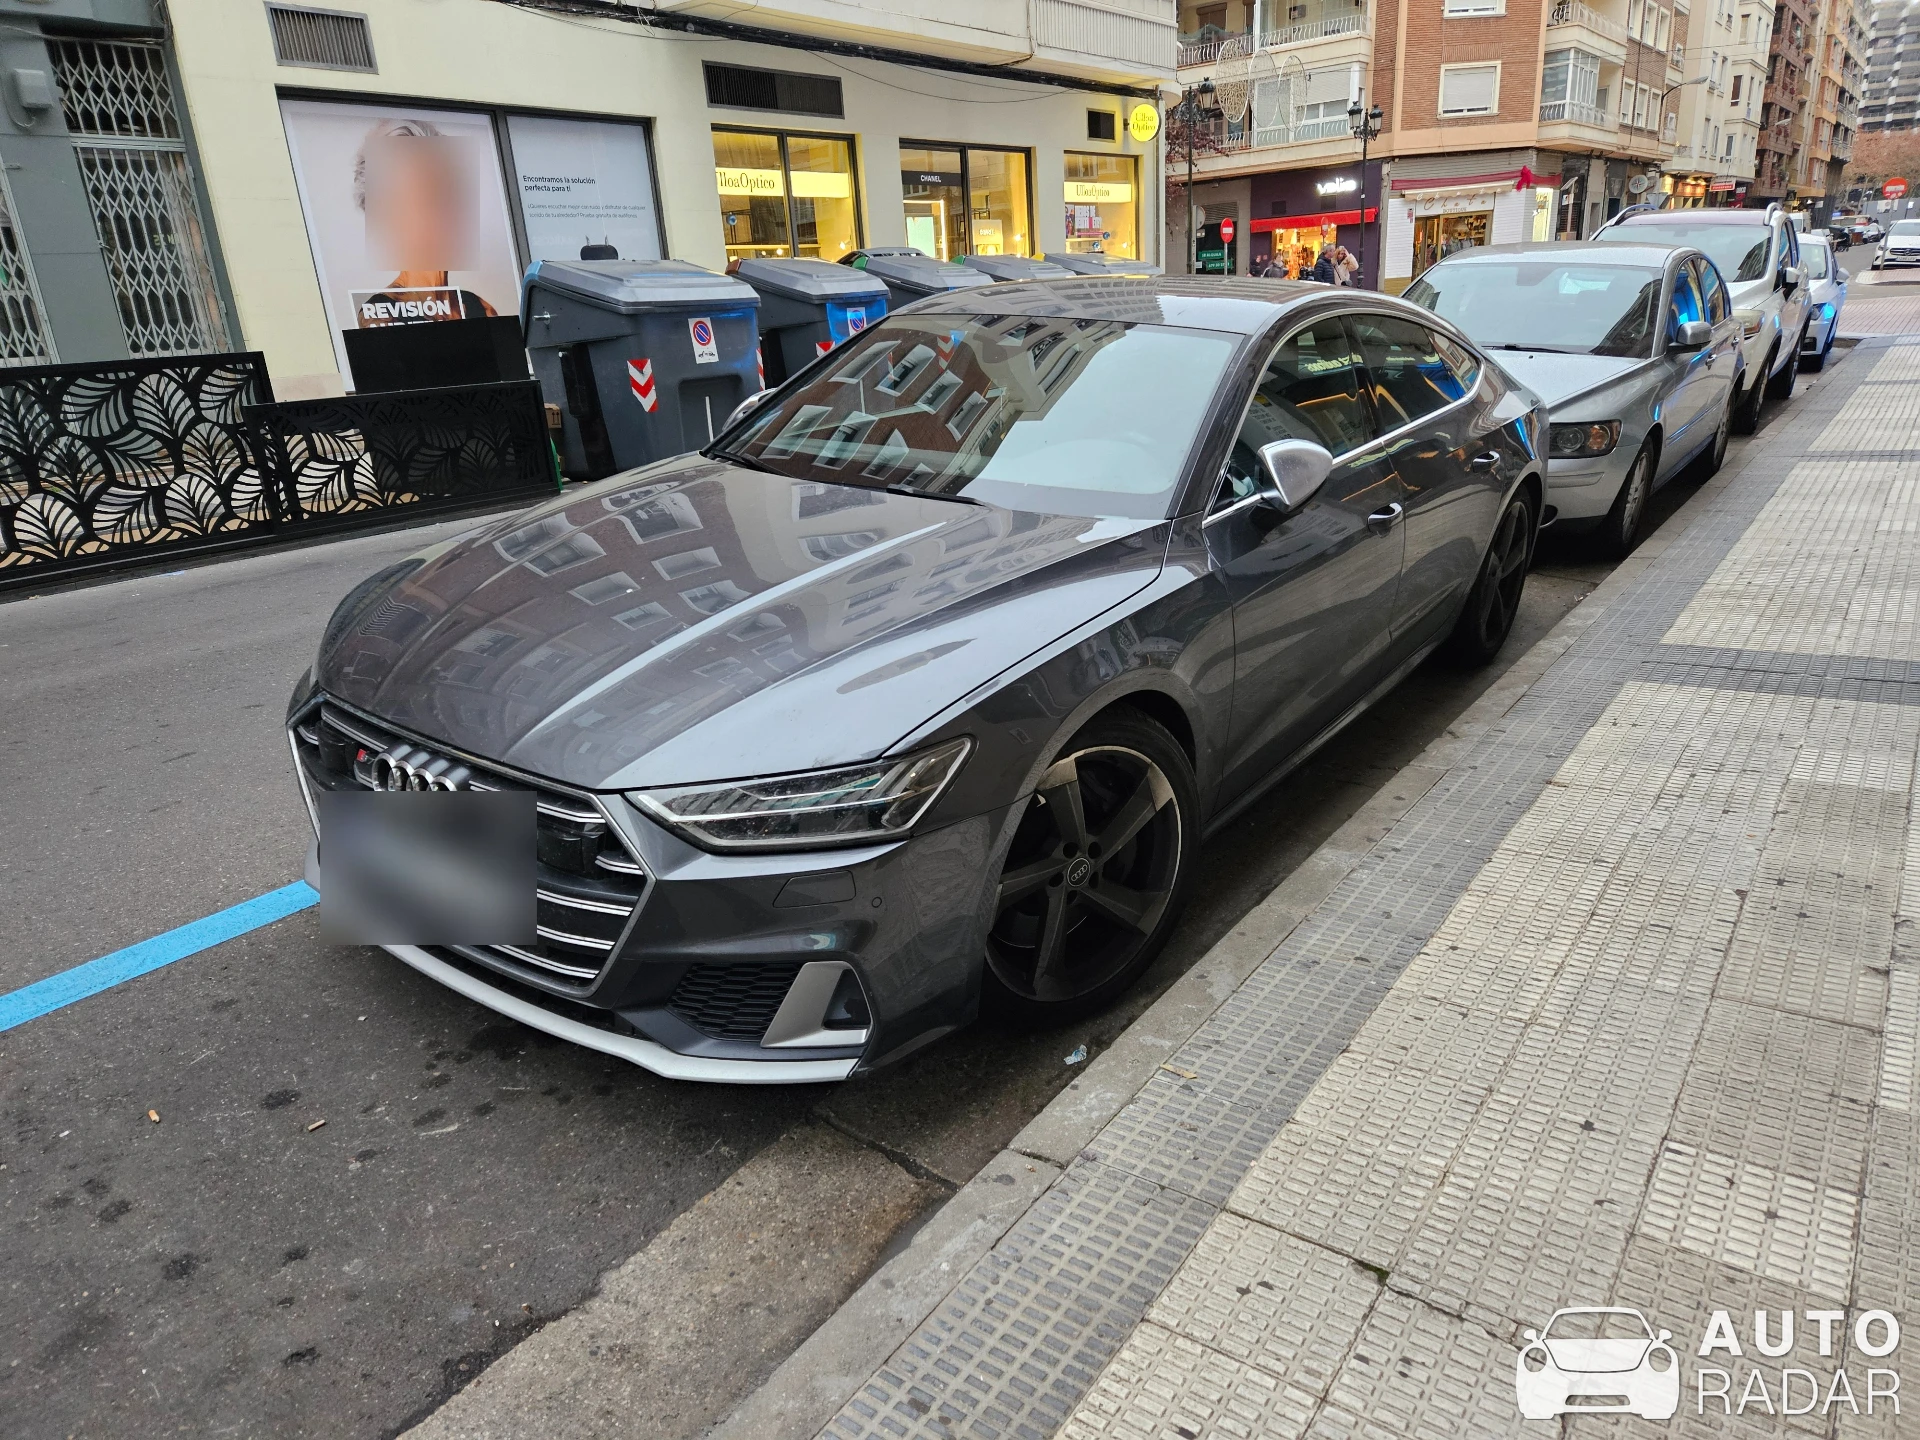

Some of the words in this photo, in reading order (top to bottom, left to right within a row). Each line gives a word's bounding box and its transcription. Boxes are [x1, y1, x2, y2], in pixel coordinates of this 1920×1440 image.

[1135, 112, 1154, 121] Ulloa
[1132, 121, 1156, 133] Optico
[522, 175, 564, 184] Encontramos
[563, 176, 570, 184] la
[571, 177, 596, 185] solución
[715, 171, 775, 193] lloaOptico
[920, 174, 942, 183] CHANEL
[524, 184, 551, 192] perfecta
[551, 185, 566, 193] para
[1423, 193, 1487, 211] Chata
[361, 296, 452, 320] REVISIÓN
